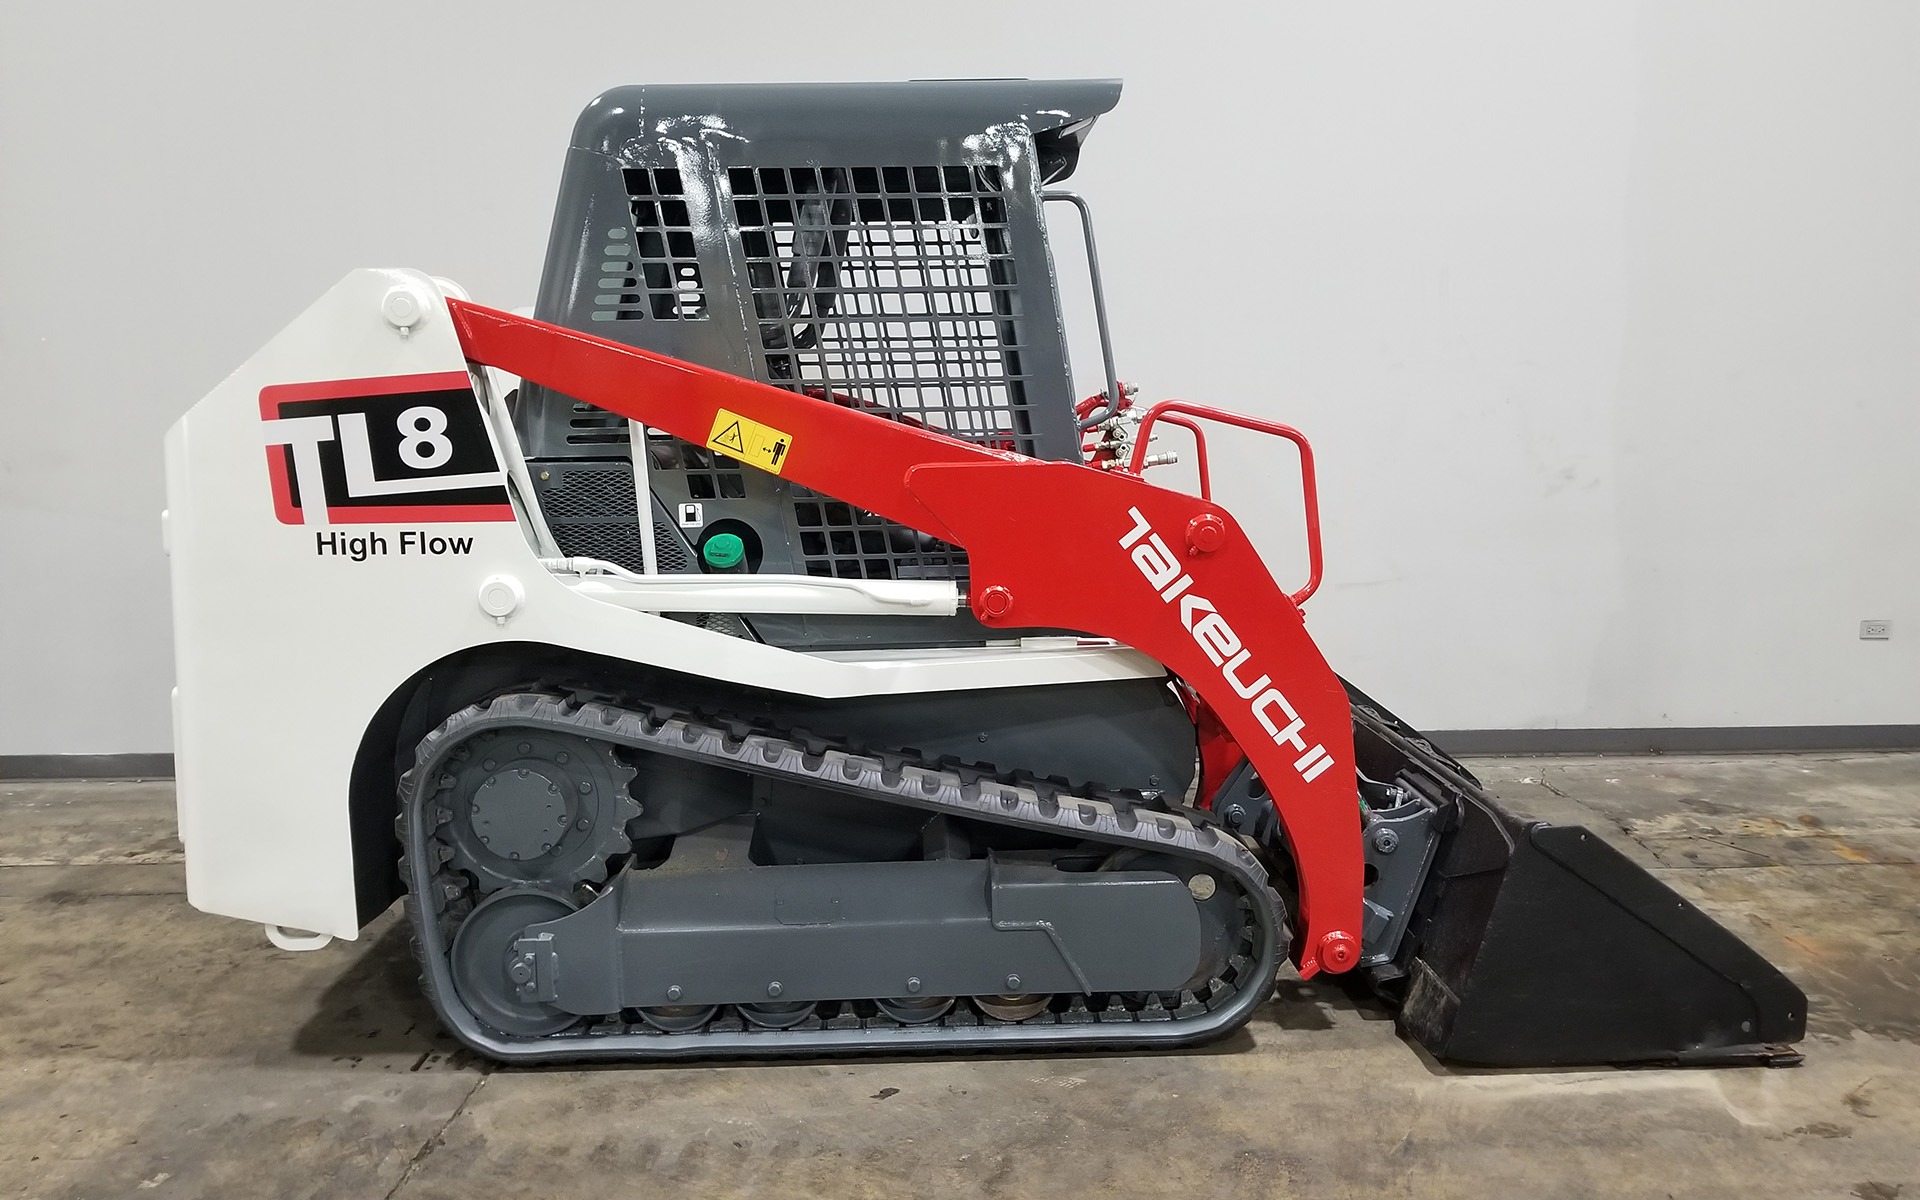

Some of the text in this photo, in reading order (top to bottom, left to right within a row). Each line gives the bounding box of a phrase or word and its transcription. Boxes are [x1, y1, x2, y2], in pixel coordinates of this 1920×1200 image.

[262, 406, 506, 525] TL8
[316, 531, 474, 562] High Flow
